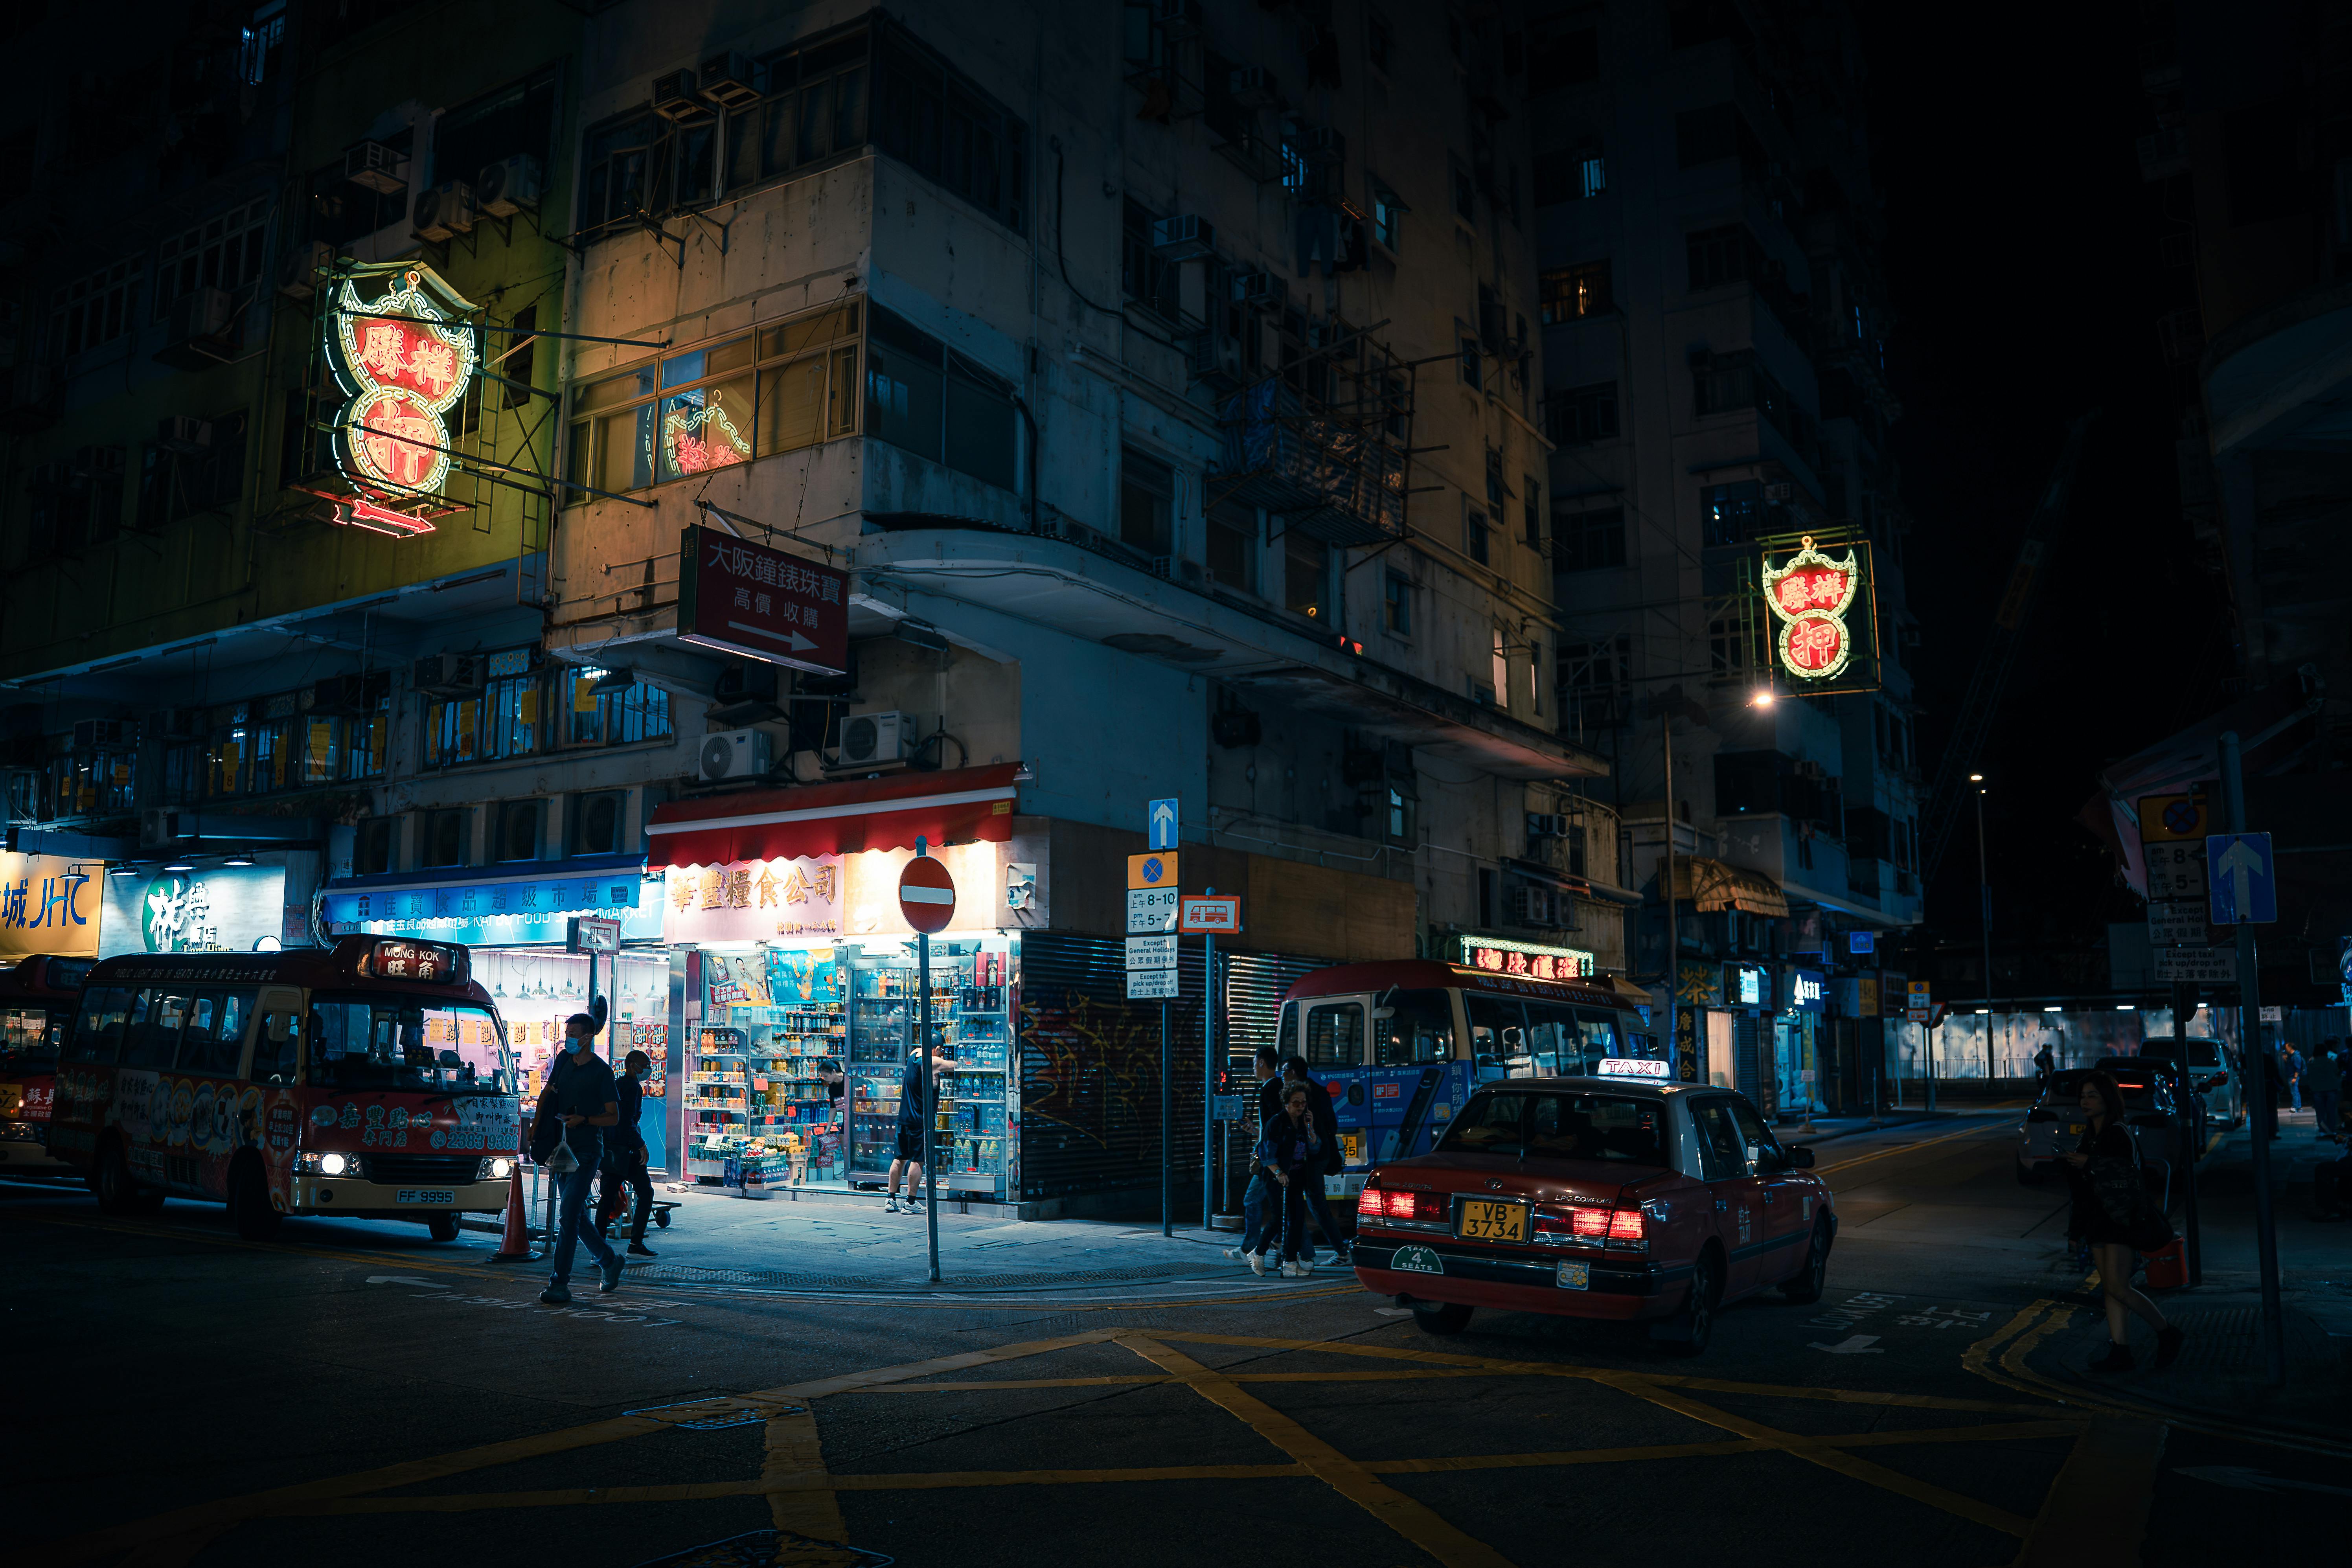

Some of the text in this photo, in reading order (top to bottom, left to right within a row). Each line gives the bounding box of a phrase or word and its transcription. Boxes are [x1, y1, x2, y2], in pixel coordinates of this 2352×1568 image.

[366, 399, 435, 483] 押
[708, 542, 841, 605] 大阪鐘錶珠寶
[735, 587, 818, 629] 高價 收購
[1791, 621, 1837, 666] 押
[2150, 857, 2170, 867] 上午
[670, 864, 838, 913] 華豐糧食公司
[29, 874, 90, 929] JHC
[383, 881, 598, 916] 佳寶食品超級市場
[1131, 900, 1146, 908] 上午
[2171, 906, 2204, 915] Except
[1131, 920, 1146, 928] 下午
[2151, 917, 2184, 925] General
[384, 947, 439, 962] MONG KOK
[1129, 956, 1175, 965] 公眾假期例外
[387, 960, 434, 980] 旺角
[2175, 960, 2210, 968] up/drop
[113, 968, 134, 978] PUBLIC
[133, 969, 151, 978] LIGHT
[173, 969, 195, 979] SEATS
[2157, 969, 2231, 979] 的士上落客除外
[1677, 965, 1718, 1006] 茶
[1606, 1061, 1661, 1075] TAXI
[472, 1096, 515, 1109] 自家製點心
[338, 1102, 432, 1130] 嘉豐點心
[362, 1130, 408, 1148] 專門店
[447, 1132, 519, 1150] 2383 9388
[399, 1191, 453, 1203] FF 9995
[1483, 1204, 1508, 1221] VB
[1738, 1204, 1751, 1224] 的士
[1466, 1219, 1519, 1239] 3734
[1738, 1223, 1751, 1245] TAXI
[1411, 1252, 1421, 1263] 4
[1401, 1263, 1433, 1271] SEATS
